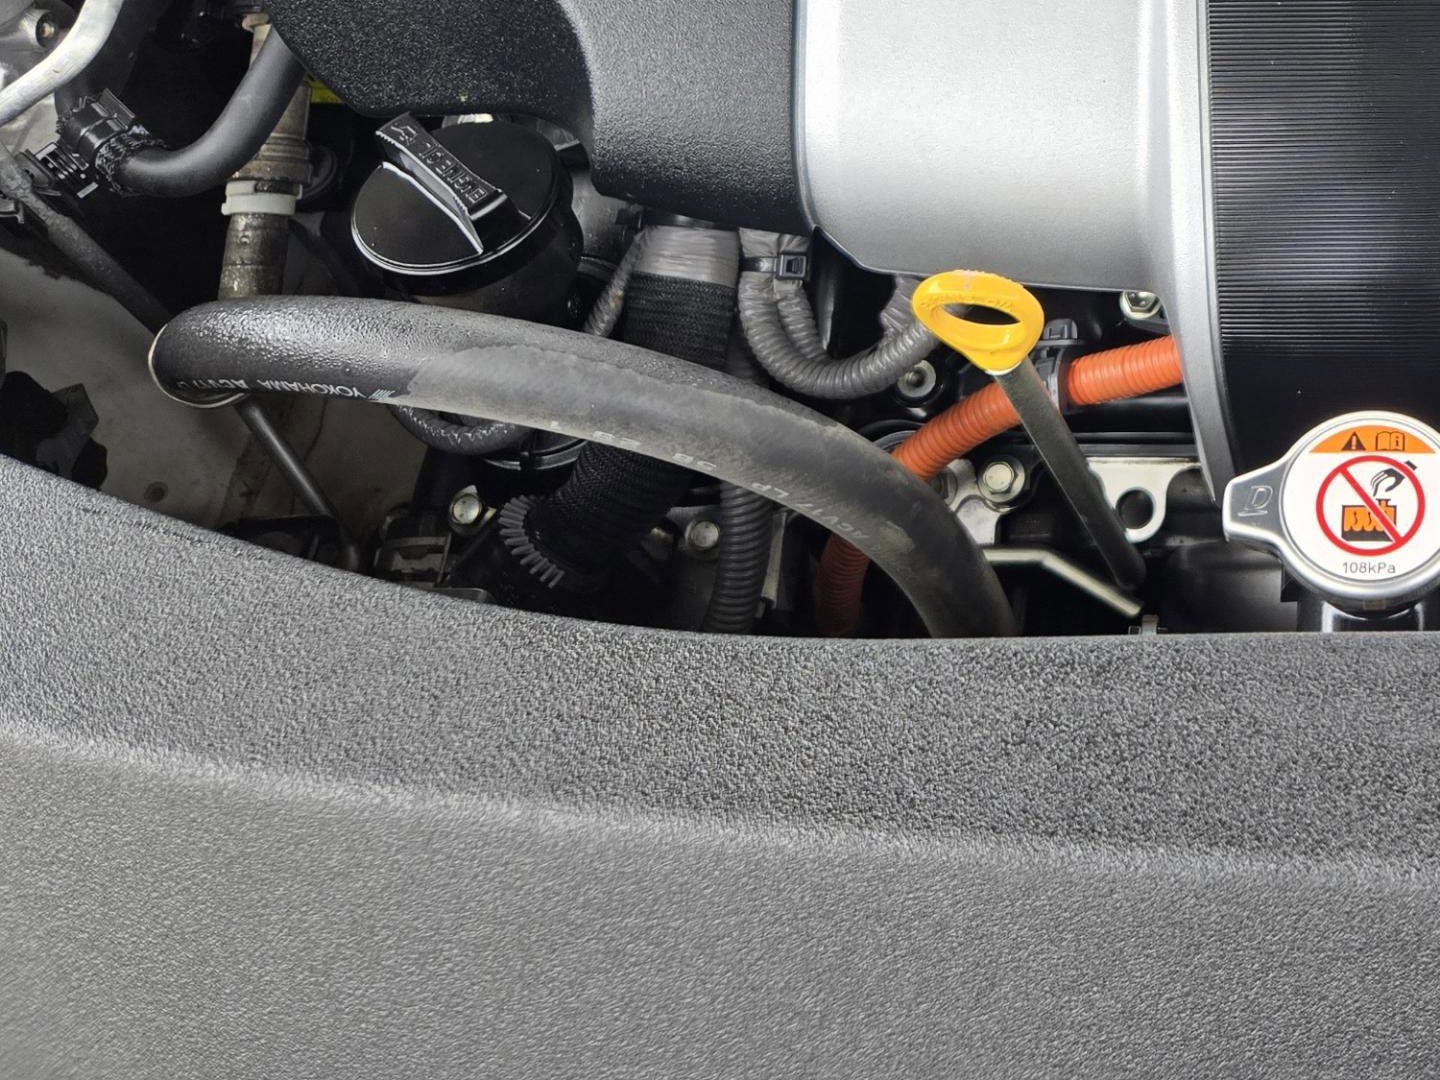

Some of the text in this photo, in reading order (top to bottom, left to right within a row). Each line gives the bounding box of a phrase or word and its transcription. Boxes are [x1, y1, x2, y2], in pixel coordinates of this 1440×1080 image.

[434, 159, 489, 204] ENGINE
[257, 378, 367, 399] YOKOHAMA
[1342, 561, 1397, 575] 108kPa
